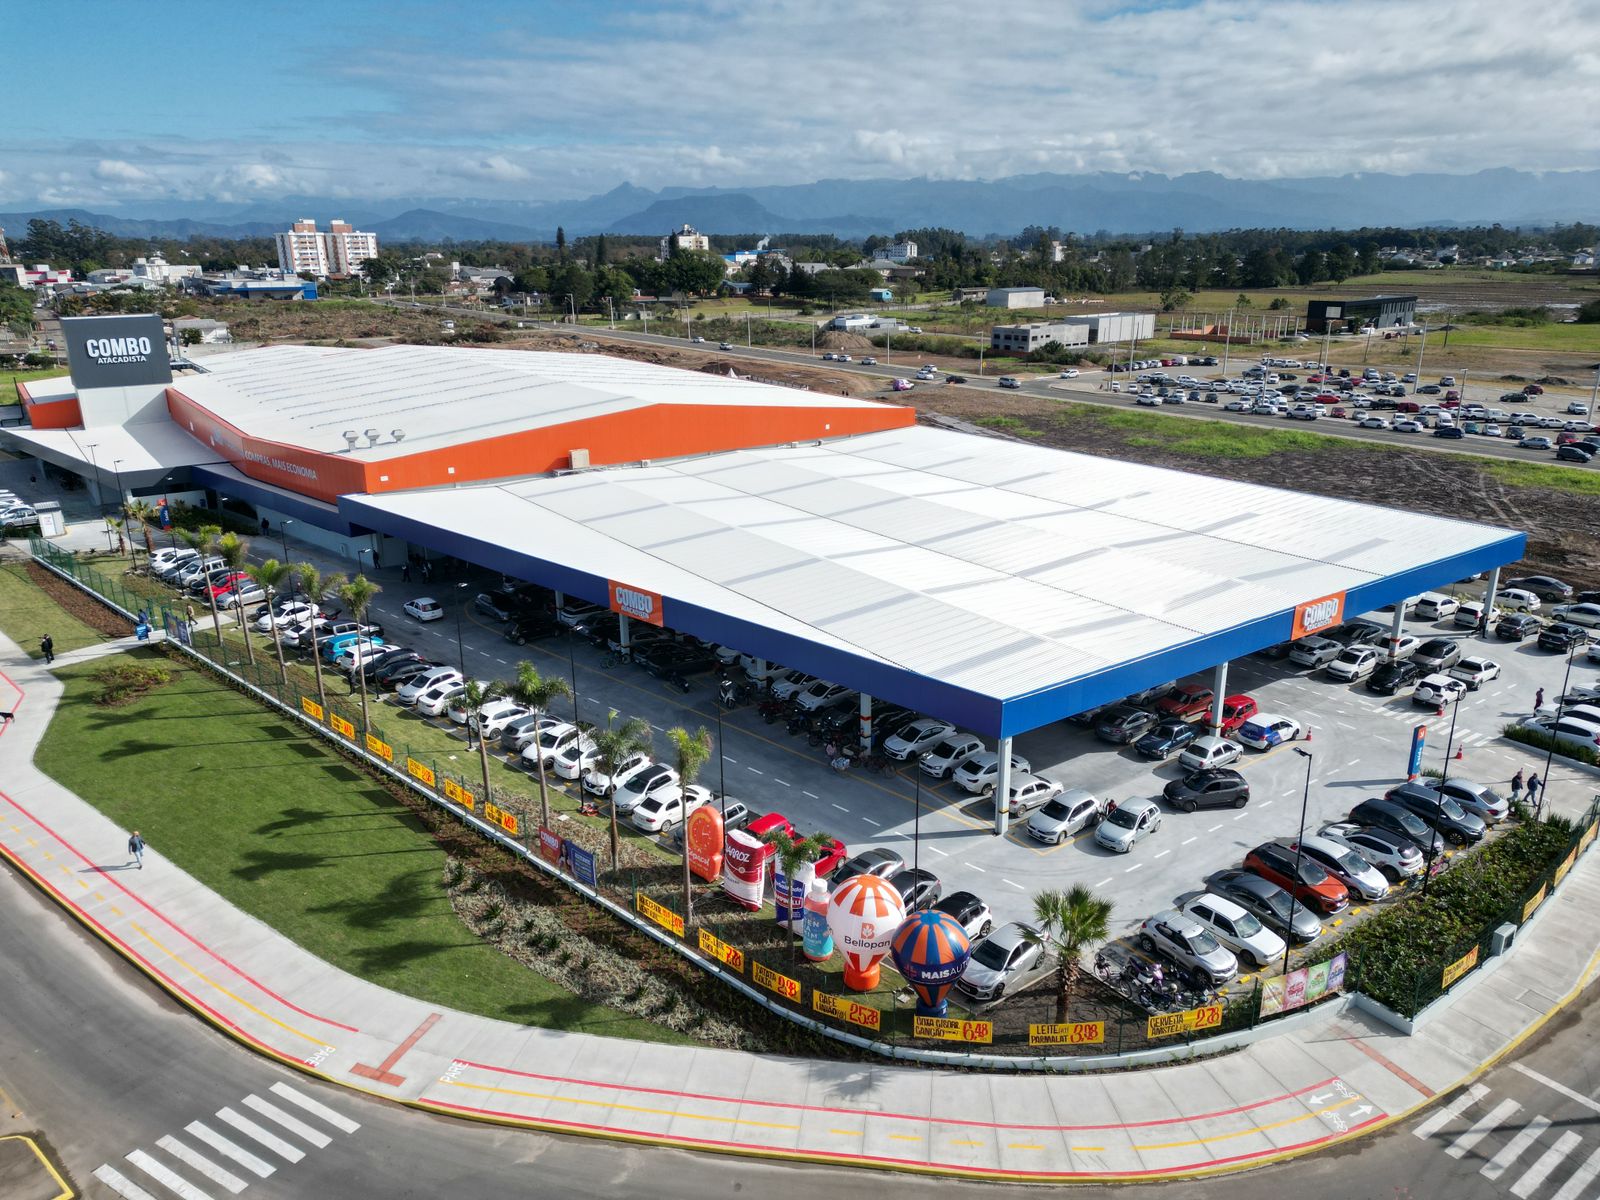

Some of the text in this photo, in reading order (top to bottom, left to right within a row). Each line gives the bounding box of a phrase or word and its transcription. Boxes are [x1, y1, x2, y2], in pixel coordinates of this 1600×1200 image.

[86, 337, 151, 357] COMBO
[98, 355, 147, 364] ATACADISTA
[616, 587, 653, 613] COMBO
[1304, 598, 1339, 627] COMBO
[844, 935, 891, 949] Bellopan
[1036, 1024, 1059, 1035] LEITE
[1031, 1035, 1068, 1043] PARMALAT
[440, 1061, 470, 1084] PARE
